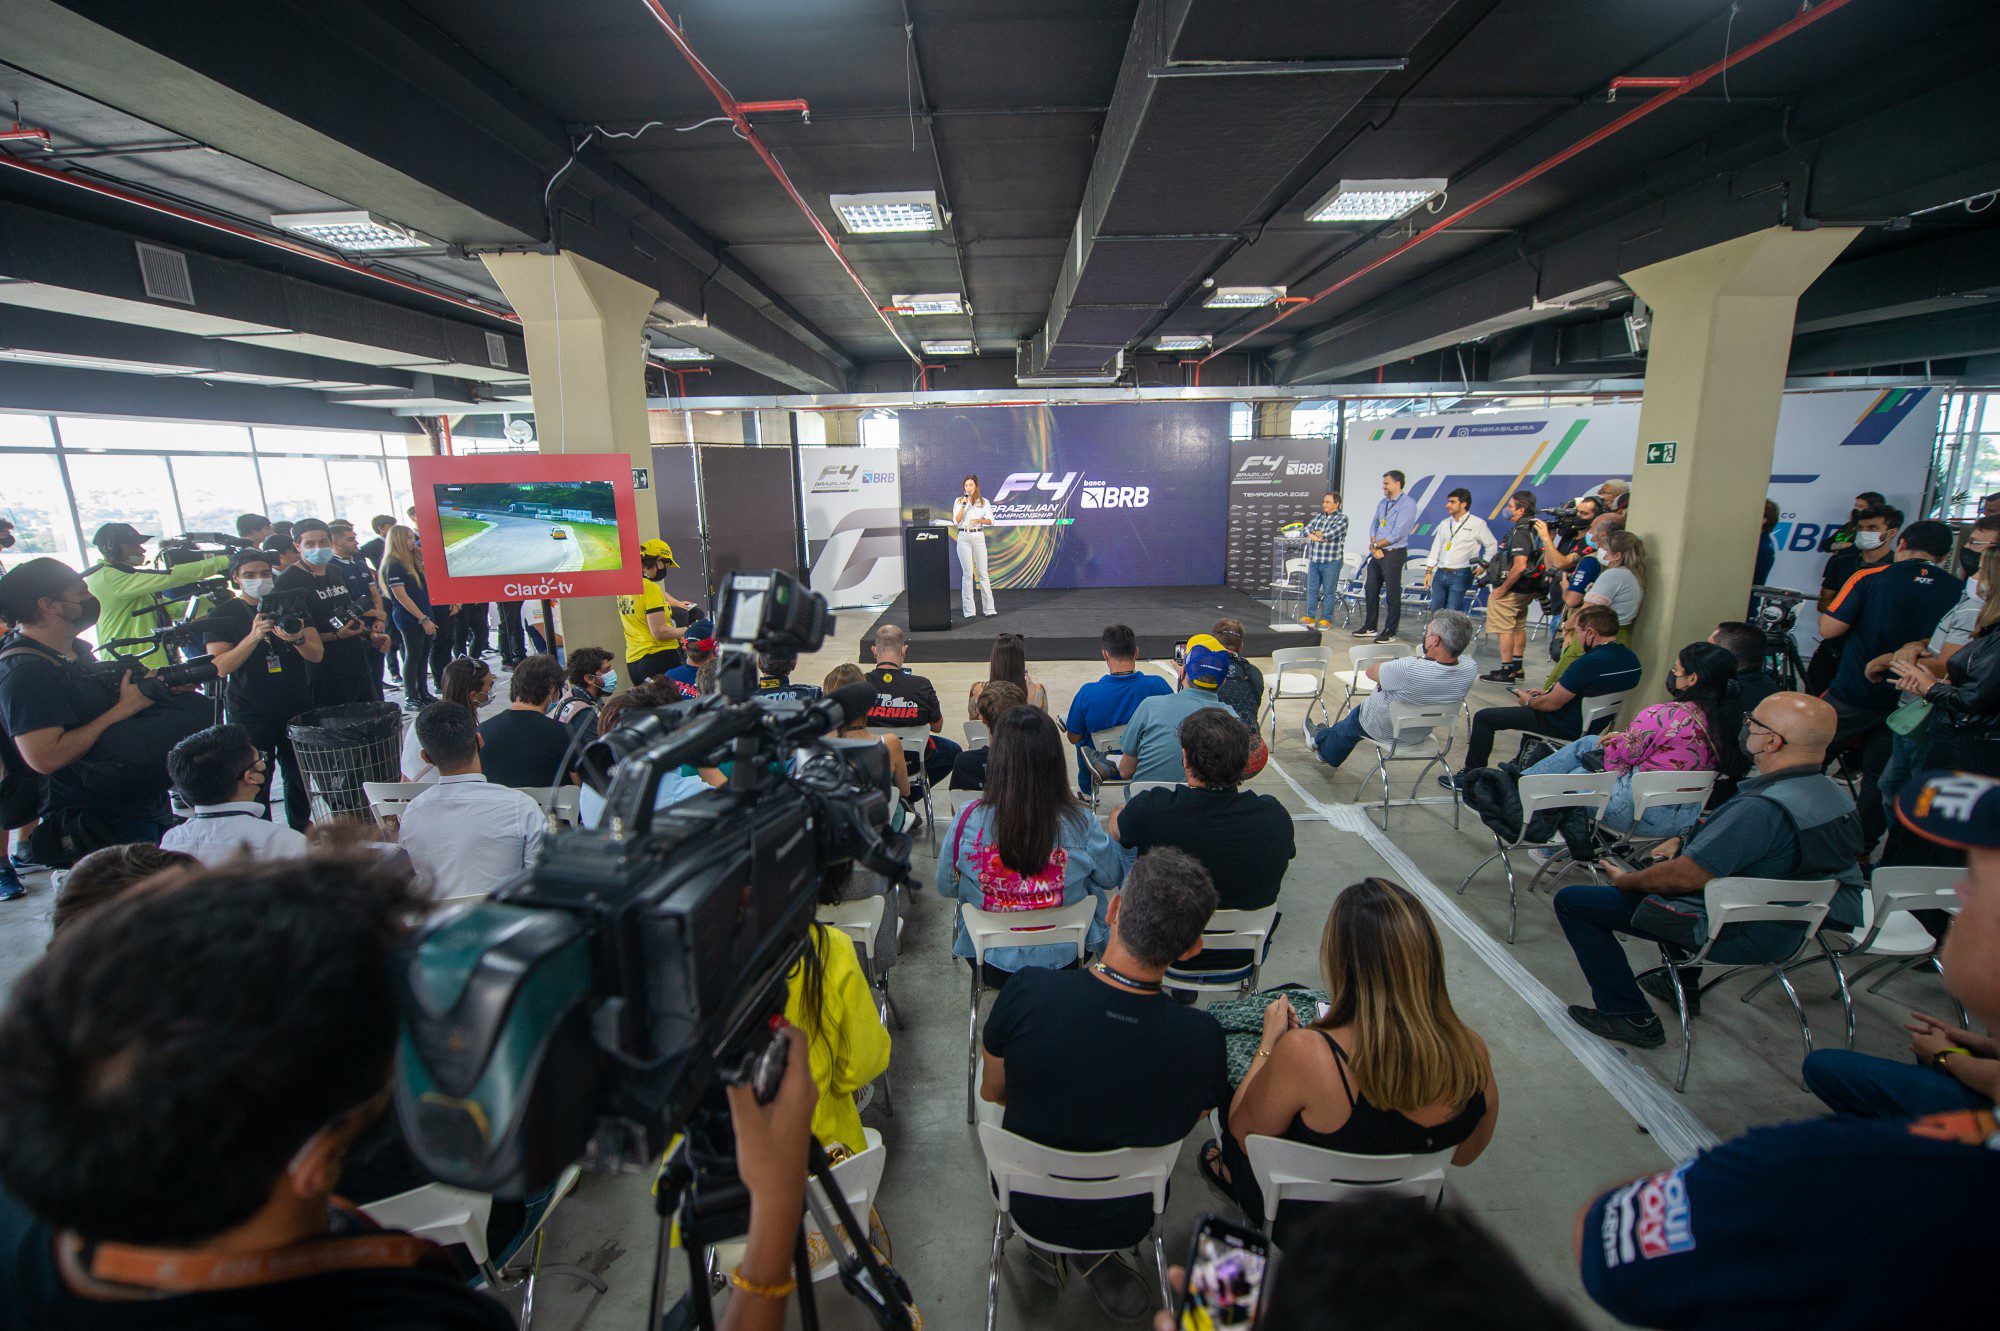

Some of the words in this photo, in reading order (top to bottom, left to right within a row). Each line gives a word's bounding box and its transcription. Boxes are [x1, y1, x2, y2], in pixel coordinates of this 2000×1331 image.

[1240, 455, 1285, 472] F4
[1299, 463, 1324, 475] BRB
[818, 465, 859, 480] F4
[873, 473, 895, 483] BRB
[994, 472, 1078, 502] F4
[1103, 486, 1150, 509] BRB
[1019, 879, 1050, 894] AM
